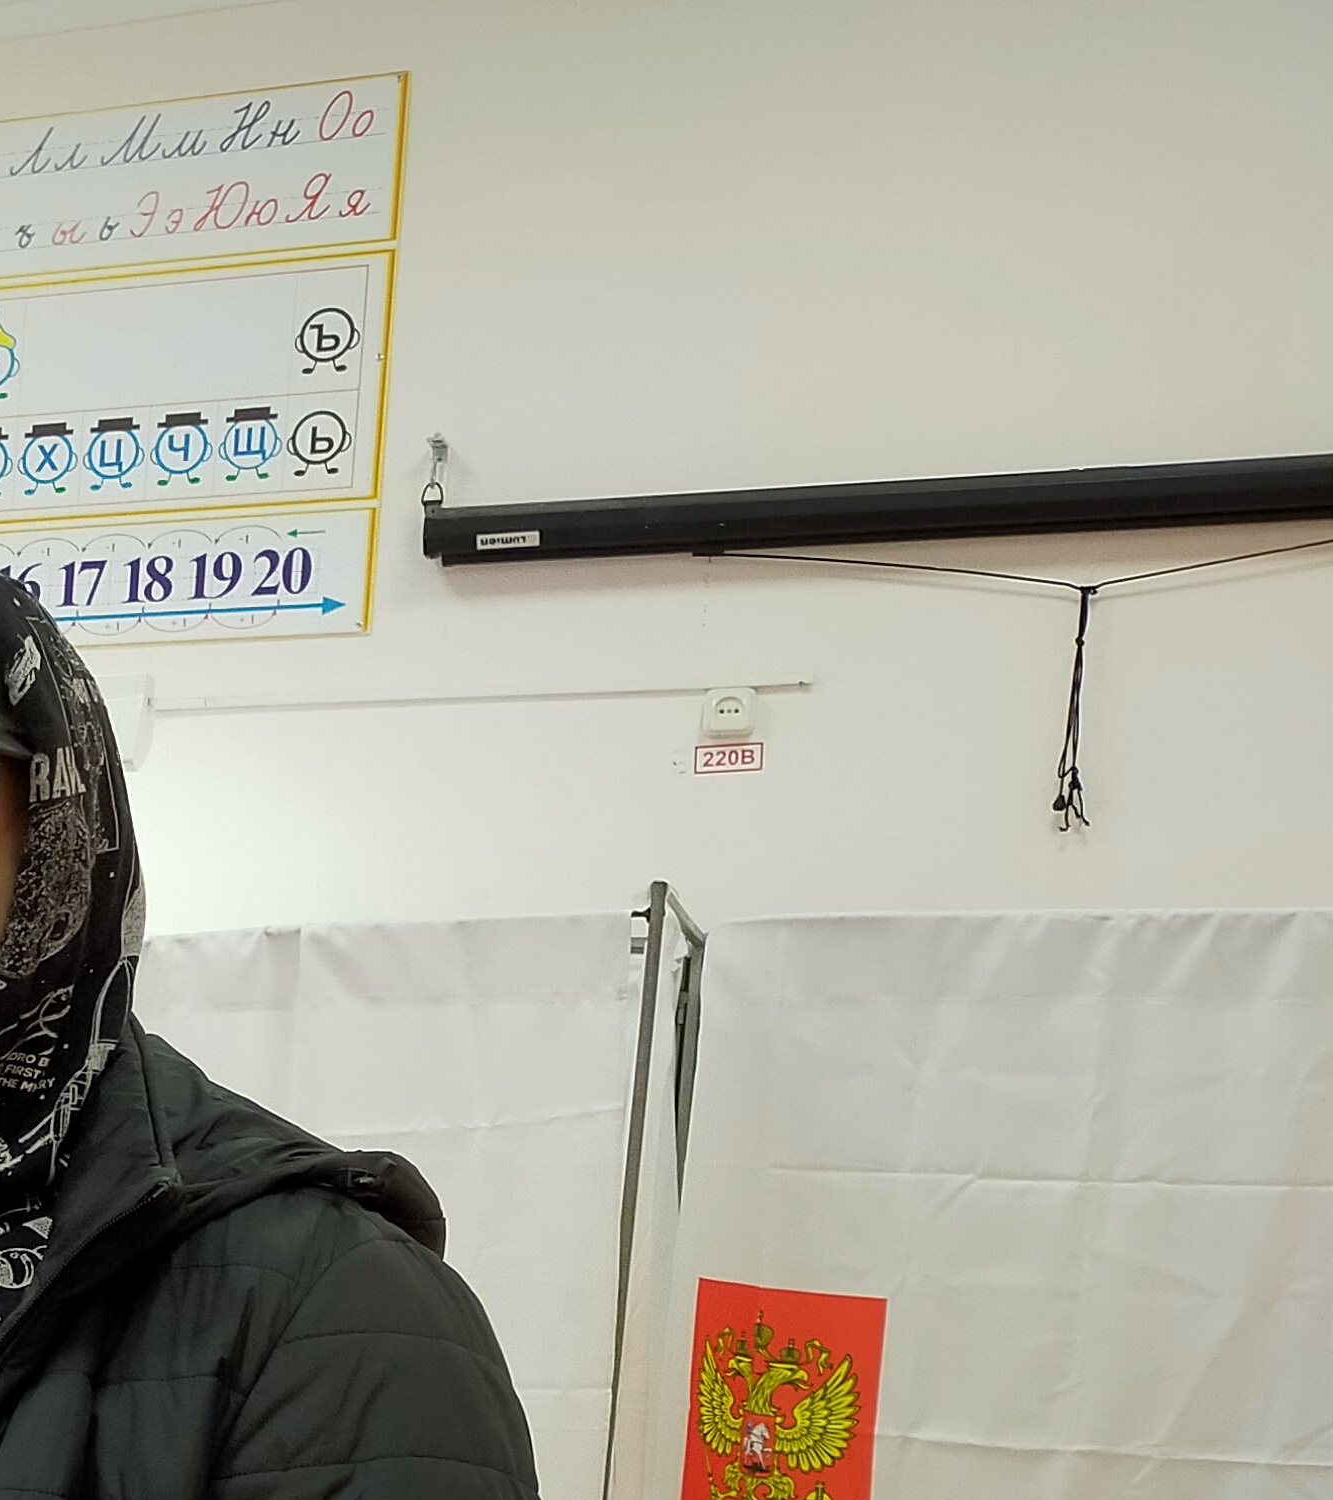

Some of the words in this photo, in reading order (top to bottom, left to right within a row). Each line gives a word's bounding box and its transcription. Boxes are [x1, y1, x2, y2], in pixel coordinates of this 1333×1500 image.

[310, 324, 341, 352] Ъ
[36, 445, 59, 471] Х
[99, 440, 123, 471] Ц
[169, 433, 190, 462] Ч
[234, 426, 267, 459] Щ
[310, 429, 333, 455] Ь
[56, 560, 107, 607] 17
[122, 556, 173, 604] 18
[188, 552, 242, 600] 19
[251, 547, 312, 596] 20
[702, 749, 755, 768] 220В
